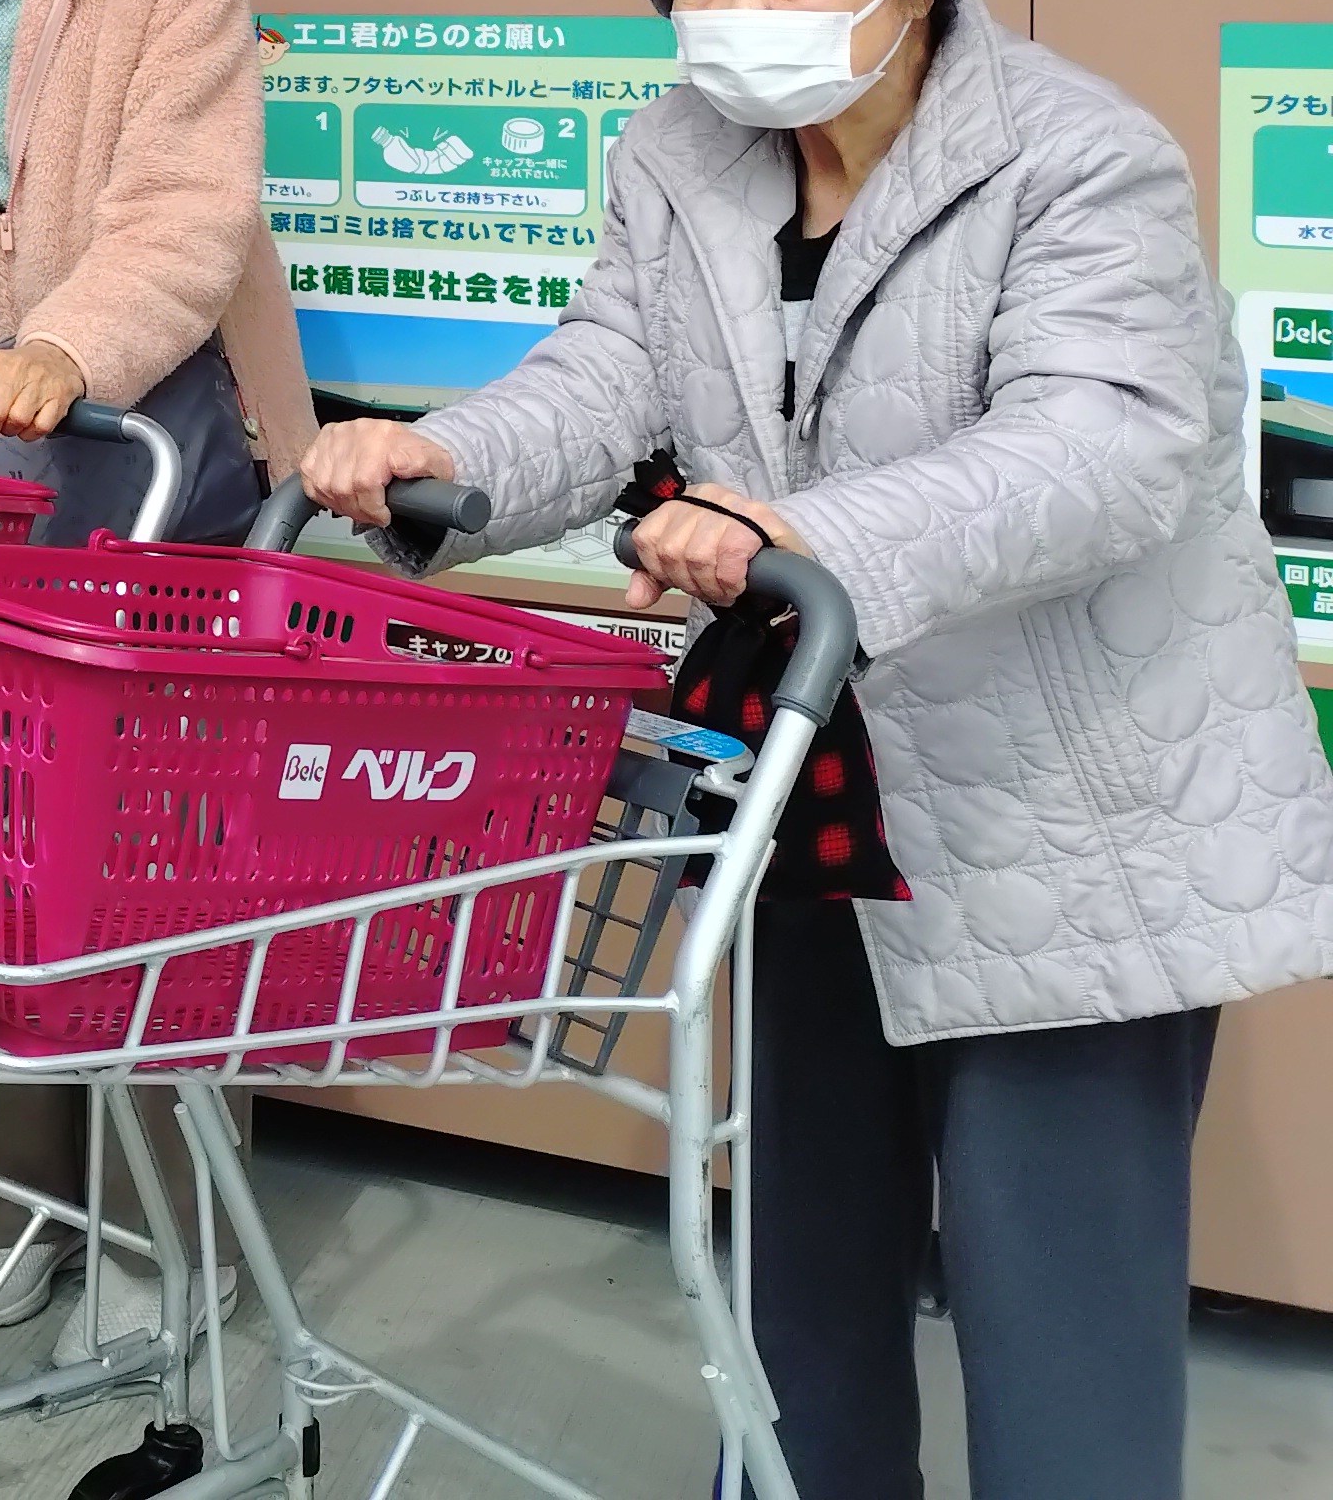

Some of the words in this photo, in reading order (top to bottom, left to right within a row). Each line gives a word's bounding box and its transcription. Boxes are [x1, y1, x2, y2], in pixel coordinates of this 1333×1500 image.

[292, 23, 565, 50] エコ君からのお願い
[262, 74, 683, 101] おります。フタもペットボトルと一緒に入れ
[1251, 94, 1333, 117] フタも
[315, 112, 328, 131] 1
[558, 118, 575, 138] 2
[396, 189, 547, 209] つぶしてお持ち下さい。
[270, 212, 595, 246] 家庭ゴミは捨てないで下さい
[283, 264, 583, 309] は循環型社会を推
[1275, 317, 1333, 346] Belc
[285, 755, 325, 783] Belc
[341, 748, 476, 801] ベルク
